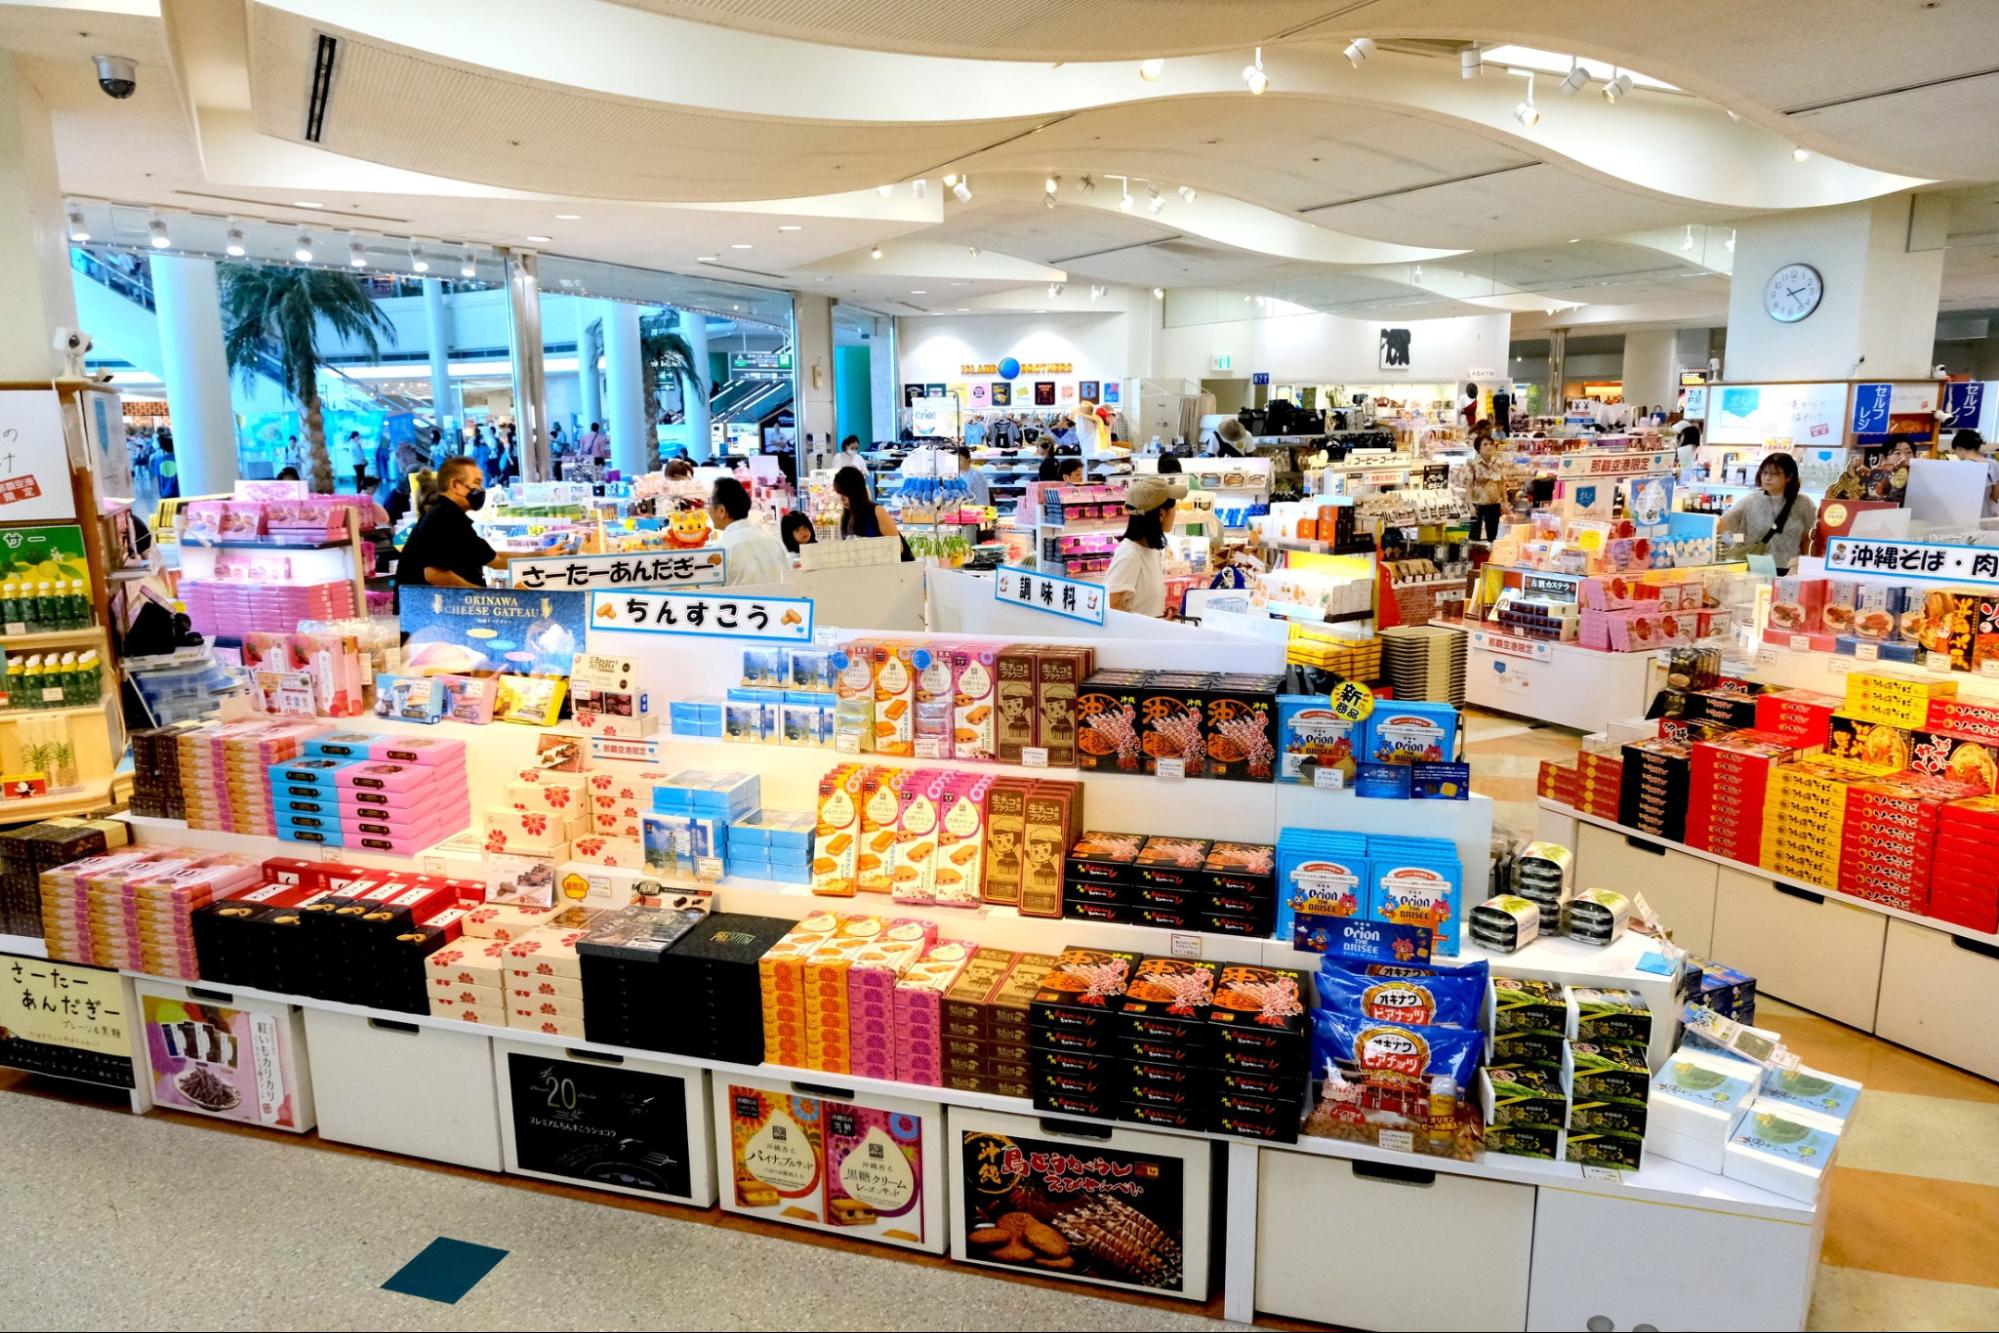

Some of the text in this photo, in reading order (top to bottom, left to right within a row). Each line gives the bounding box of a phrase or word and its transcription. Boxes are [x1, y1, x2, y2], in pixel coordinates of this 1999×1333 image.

[961, 363, 1073, 375] ISLAND BROTHERS
[1873, 386, 1887, 420] セルフ
[1963, 384, 1979, 417] セルフ
[1858, 407, 1871, 430] レジ
[522, 557, 715, 587] さーたーあんだぎー
[464, 595, 518, 607] OKINAWA
[1020, 575, 1076, 612] 調味料
[445, 605, 540, 618] CHEESE GATEAU
[627, 597, 769, 631] ちんすこう
[1341, 684, 1363, 707] 新
[1335, 702, 1360, 720] 商品
[1306, 733, 1334, 745] Orion
[1395, 740, 1423, 752] Orion
[1309, 888, 1338, 901] Orion
[1400, 894, 1430, 908] Orion
[1344, 927, 1380, 941] Orion
[11, 961, 89, 988] さーたー
[22, 988, 121, 1020] あんだぎー
[1380, 995, 1417, 1006] オキナワ
[1373, 1039, 1412, 1053] オキナワ
[257, 1023, 275, 1102] 紅いもカリカリ
[545, 1076, 577, 1110] 20
[529, 1116, 617, 1137] プレミアムちんすこうショコラ
[746, 1149, 813, 1171] パイナップルサンド
[1001, 1145, 1133, 1178] 島とうがらし
[843, 1168, 907, 1189] 黒糖クリーム
[1043, 1173, 1144, 1197] えびせんべい
[856, 1183, 900, 1198] レーズンサンド
